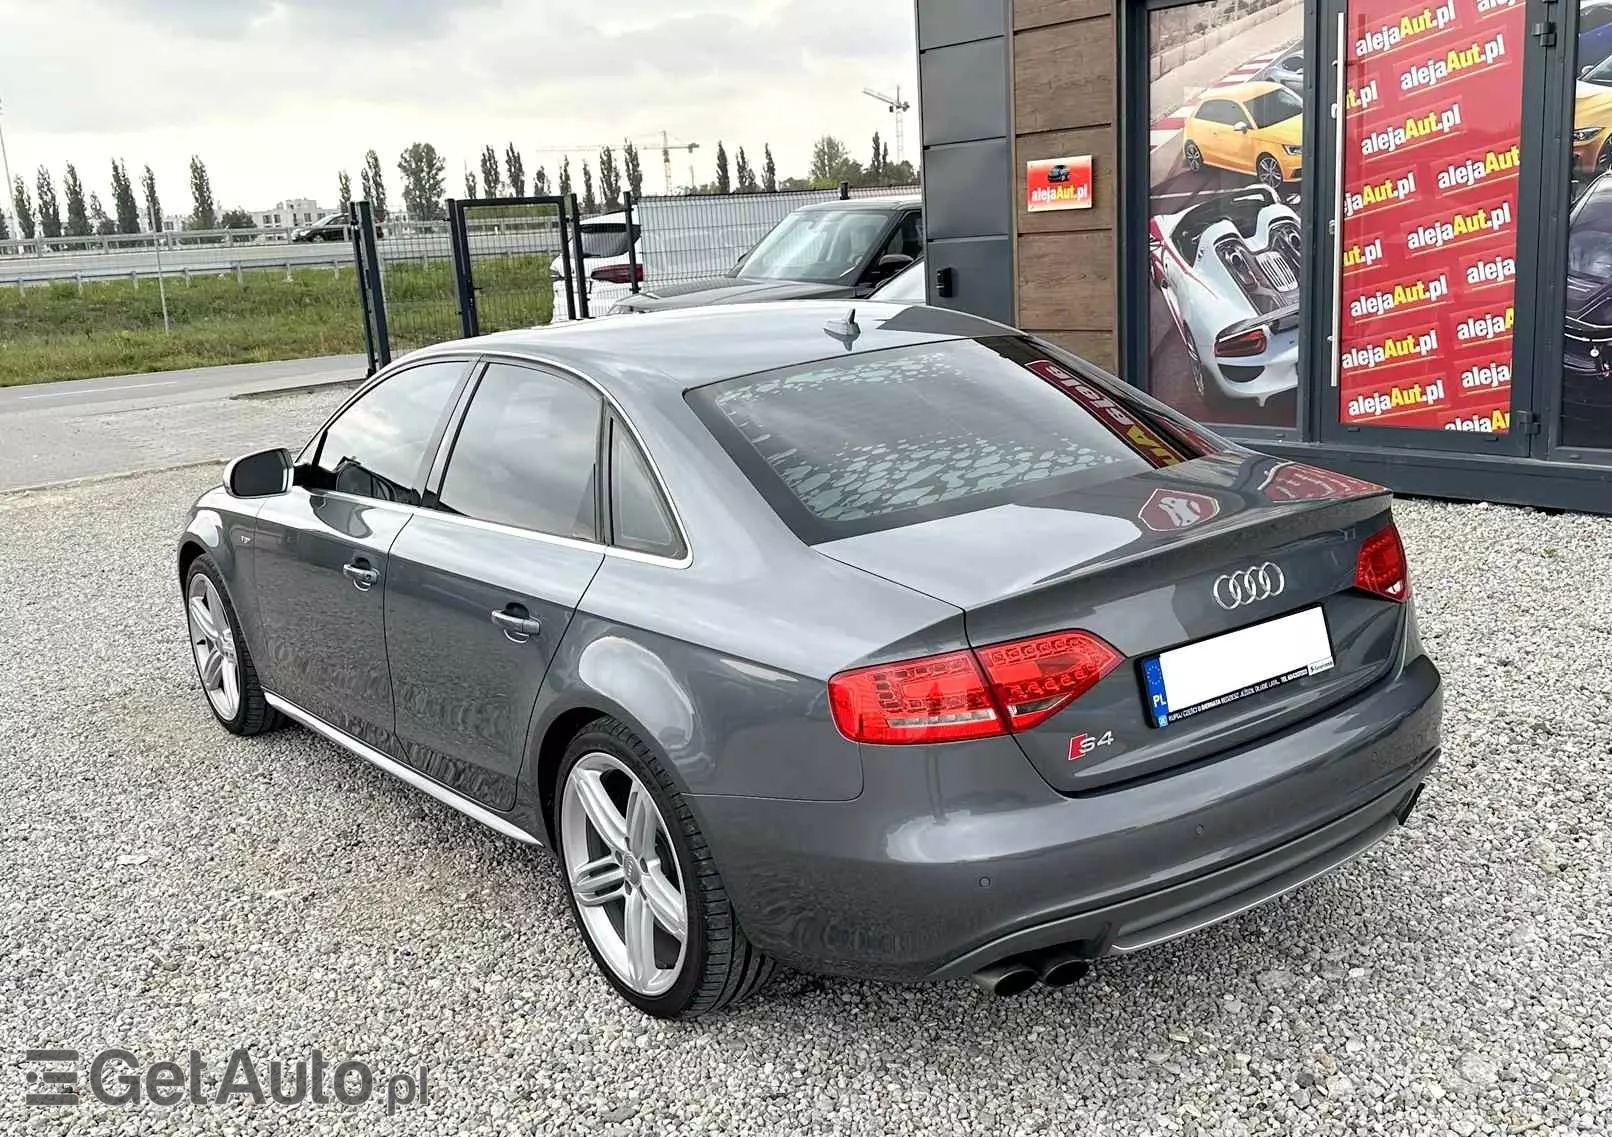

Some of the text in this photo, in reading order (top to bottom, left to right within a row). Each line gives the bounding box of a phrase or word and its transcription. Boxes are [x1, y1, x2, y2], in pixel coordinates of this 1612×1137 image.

[1356, 2, 1456, 56] alejaAut.pl
[1400, 34, 1505, 90] alejaAut.pl
[1361, 104, 1462, 156] alejaAut.pl
[1031, 184, 1088, 203] alejaAut.pl
[1407, 202, 1511, 250] alejaAut.pl
[1350, 275, 1448, 317] alejaAut.pl
[1342, 329, 1438, 368] alejaAut.pl
[1348, 379, 1445, 416] alejaAut.pl
[1152, 694, 1167, 708] PL
[1079, 730, 1114, 754] S4
